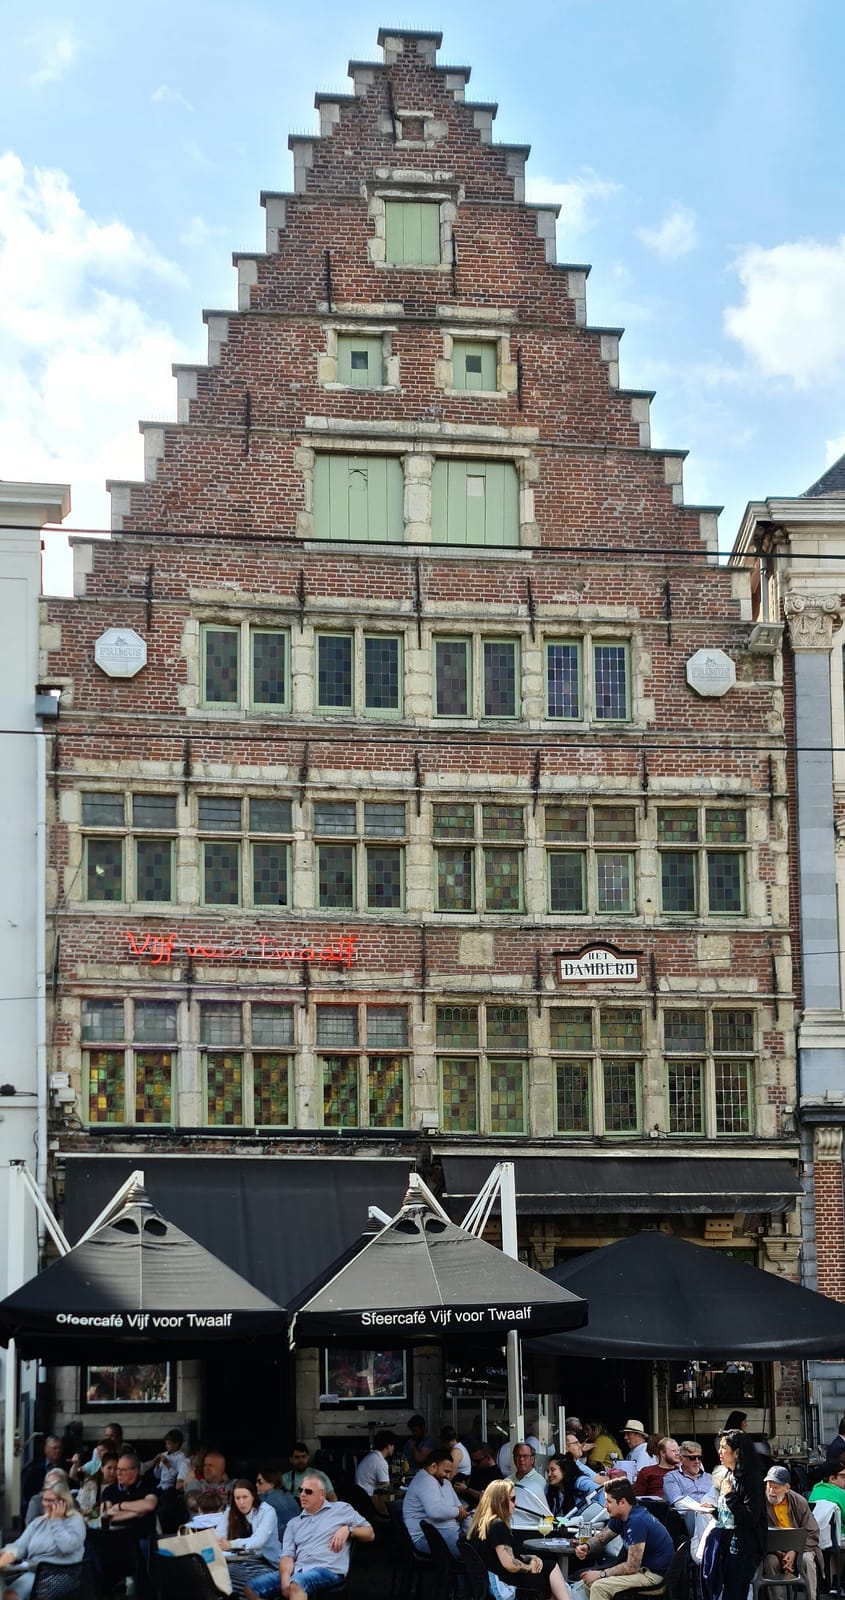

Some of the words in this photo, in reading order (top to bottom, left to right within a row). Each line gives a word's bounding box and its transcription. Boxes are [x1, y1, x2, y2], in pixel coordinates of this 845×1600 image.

[126, 932, 177, 964] Vijf
[588, 952, 608, 960] HET
[564, 963, 635, 976] DAMBERD
[127, 1314, 150, 1331] Vijf
[152, 1315, 184, 1327] voor
[187, 1313, 233, 1327] Twaalf
[361, 1310, 427, 1326] Sfeercafé
[430, 1309, 452, 1326] Vijf
[454, 1310, 485, 1323] voor
[488, 1306, 532, 1321] Twaalf
